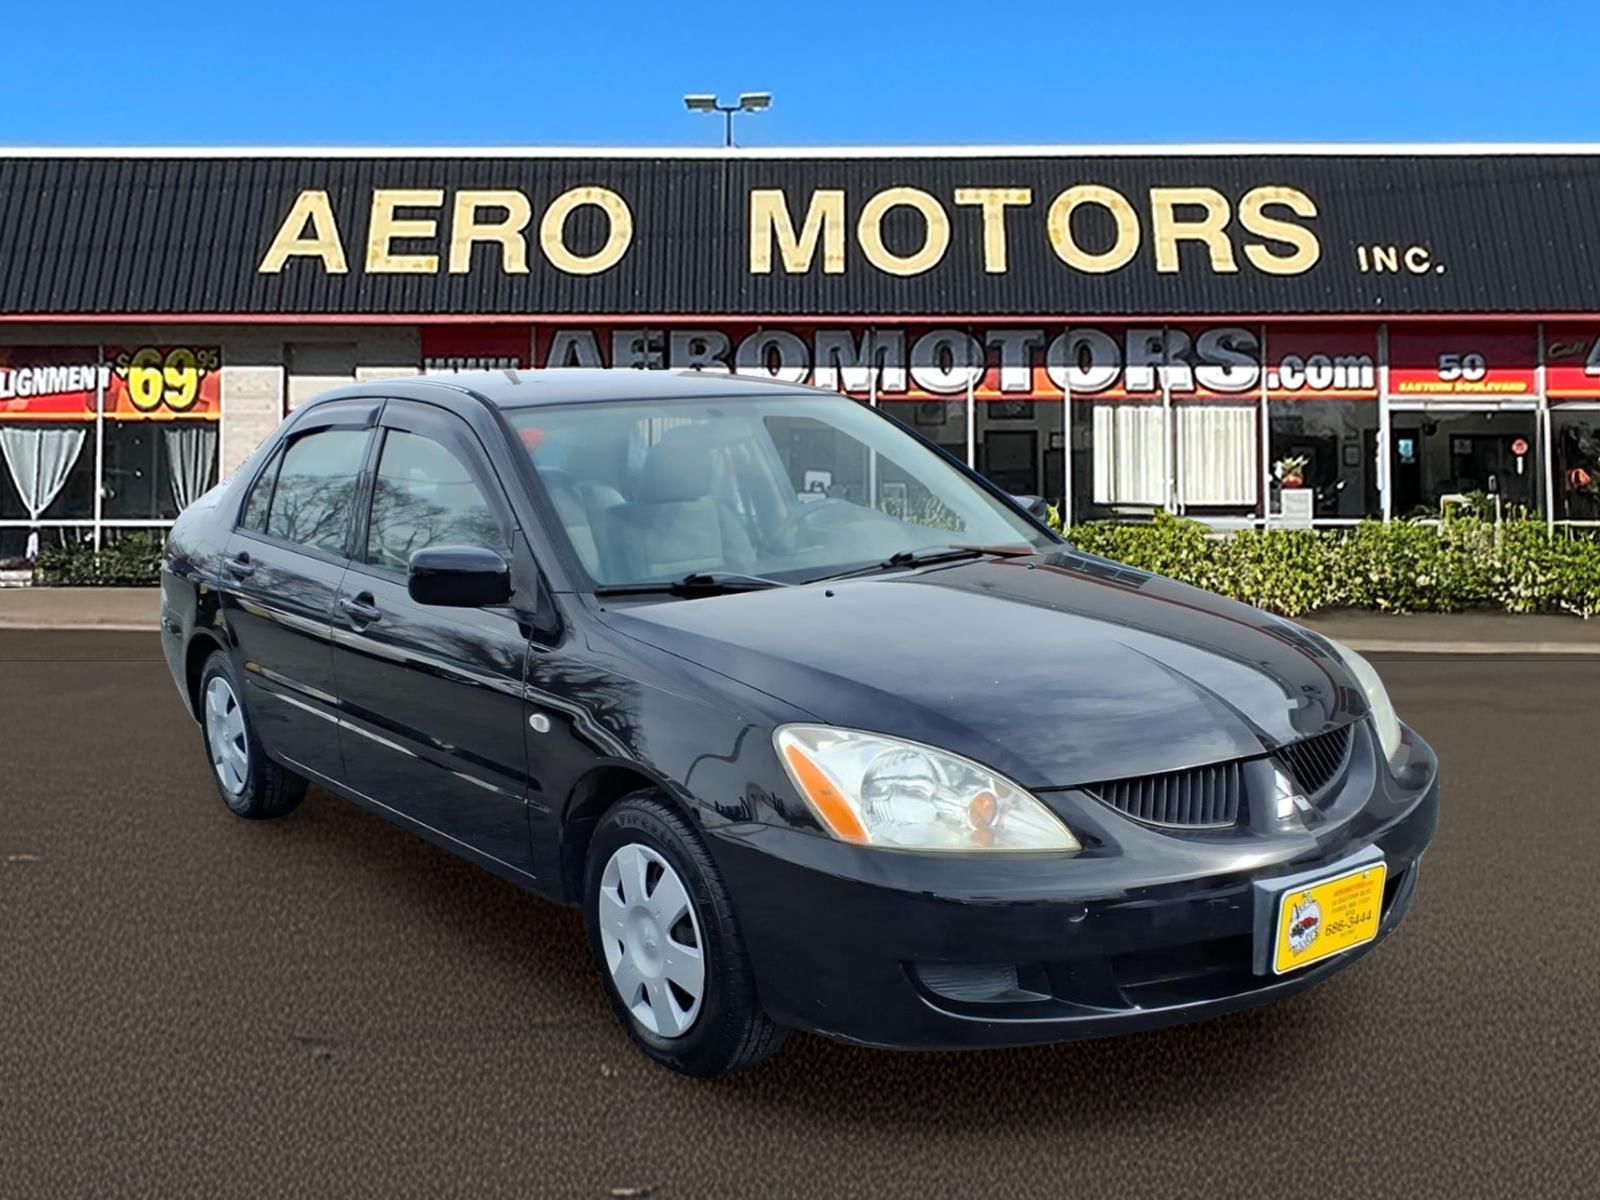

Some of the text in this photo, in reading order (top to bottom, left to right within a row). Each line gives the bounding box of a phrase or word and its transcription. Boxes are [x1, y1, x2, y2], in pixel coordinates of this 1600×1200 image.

[258, 185, 1446, 276] AERO MOTORS INC.
[1438, 354, 1486, 380] 50
